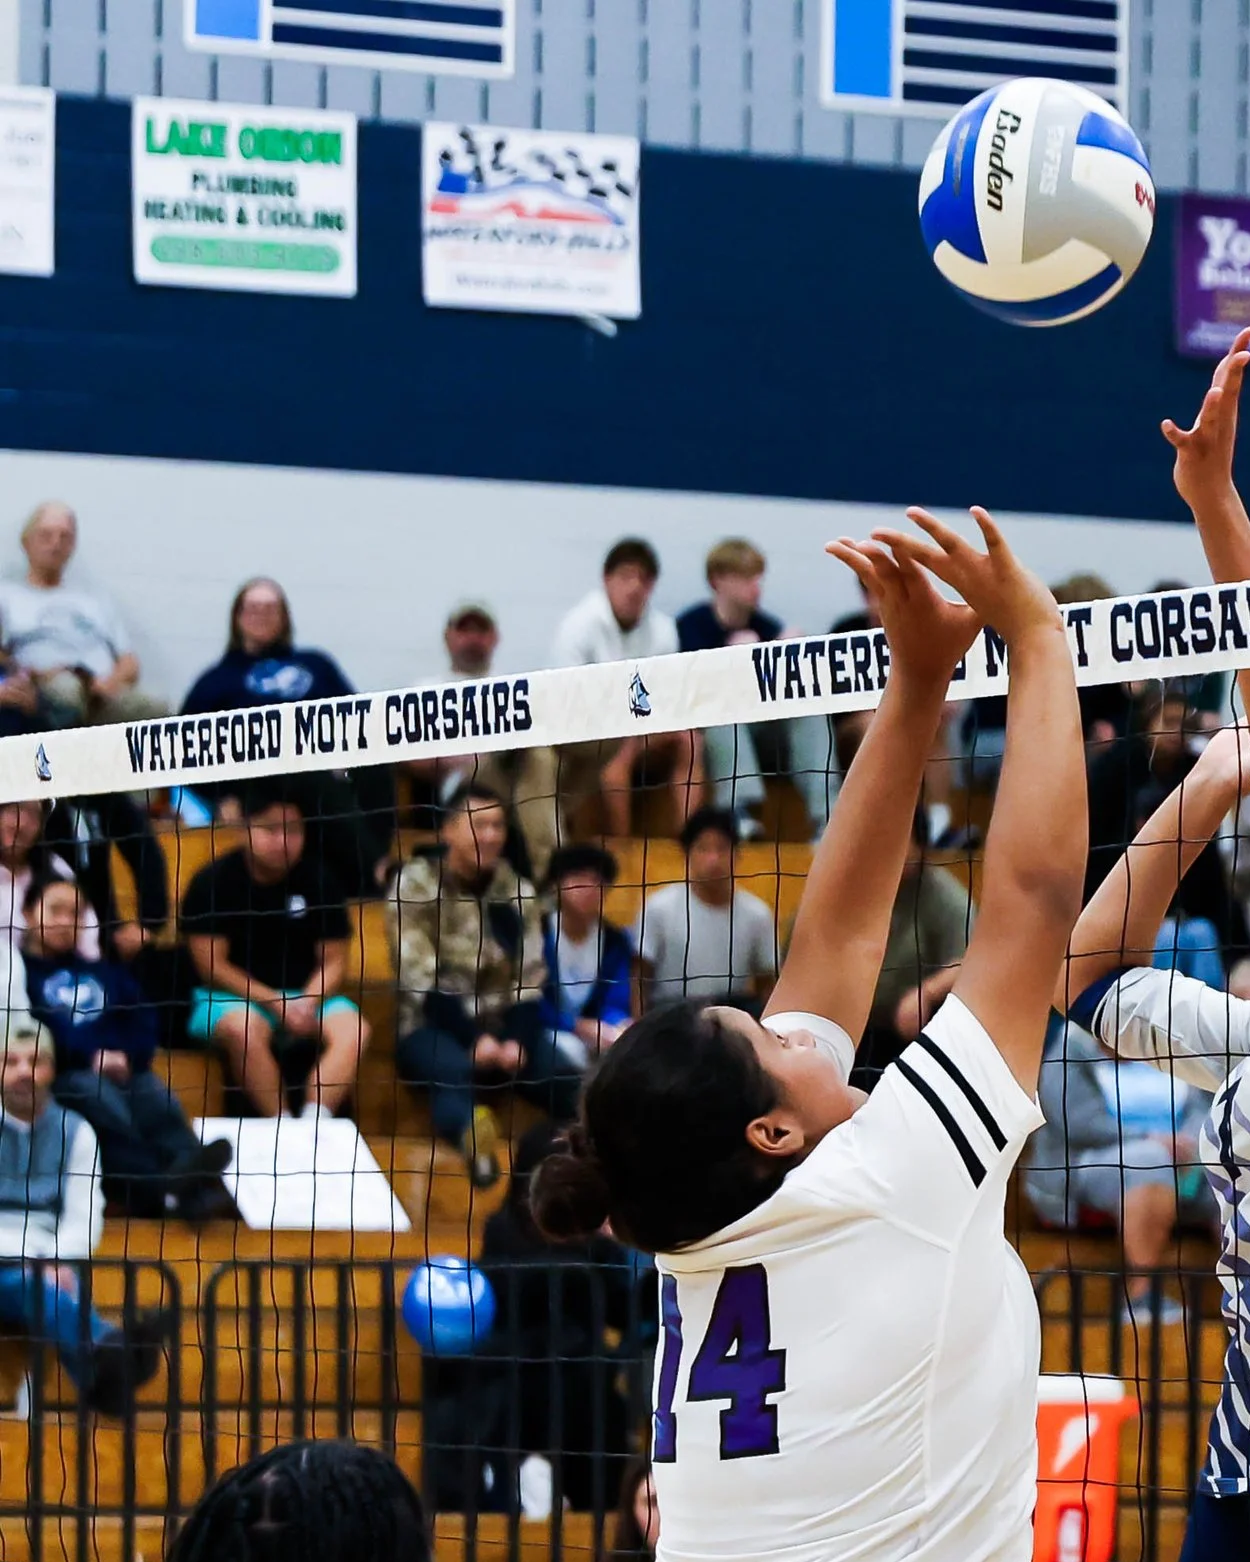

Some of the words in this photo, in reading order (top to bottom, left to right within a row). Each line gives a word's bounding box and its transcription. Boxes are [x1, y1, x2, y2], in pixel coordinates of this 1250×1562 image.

[987, 108, 1022, 212] Baden
[984, 606, 1093, 678] MT
[125, 709, 282, 773] WATERFORD
[294, 699, 372, 756] MOTT
[385, 679, 533, 745] CORSAIRS
[652, 1262, 787, 1463] 14
